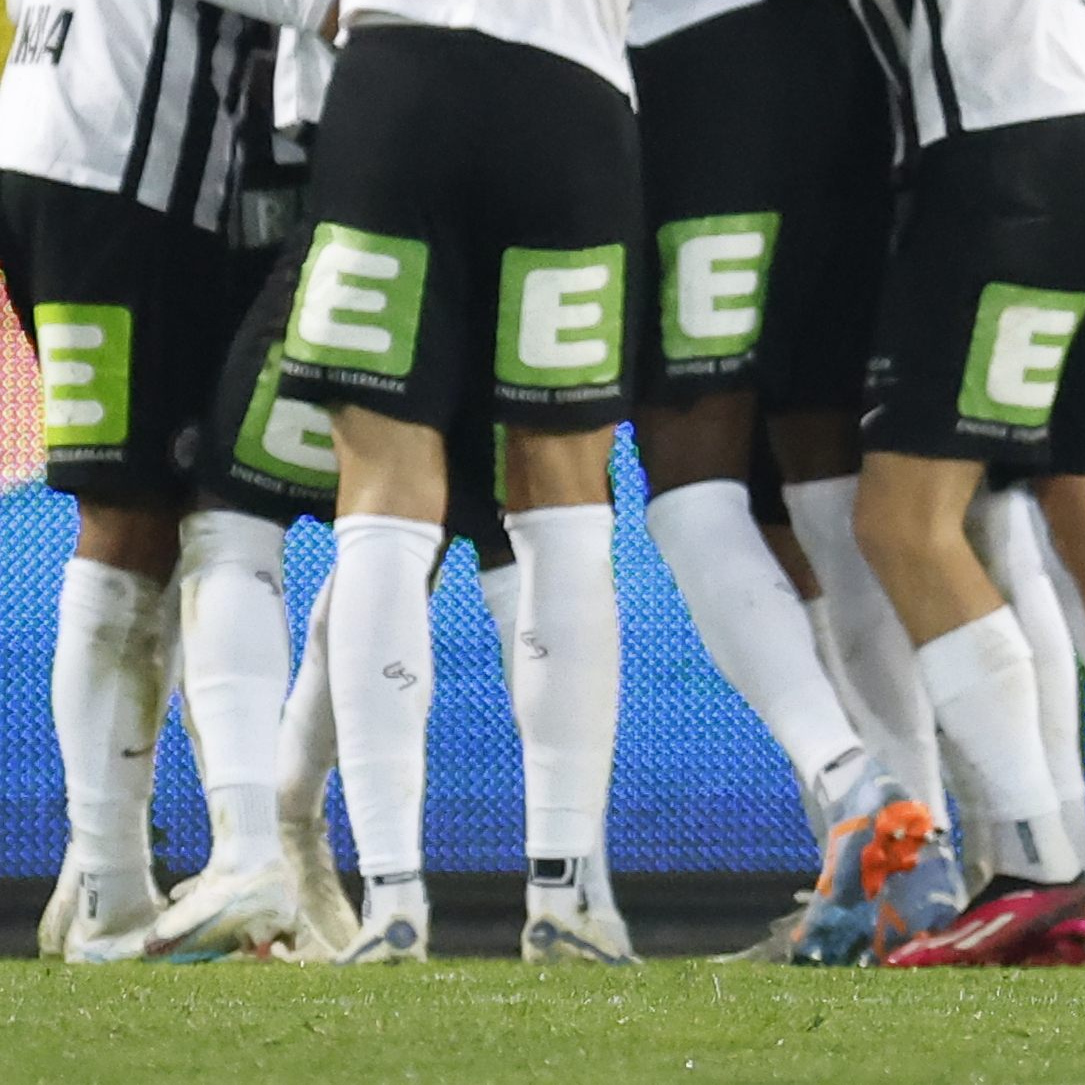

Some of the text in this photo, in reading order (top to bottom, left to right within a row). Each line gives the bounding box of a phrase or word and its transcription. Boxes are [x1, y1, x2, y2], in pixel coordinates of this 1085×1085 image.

[299, 242, 401, 354] E
[518, 265, 609, 368] E
[677, 232, 765, 339] E
[37, 322, 104, 428] E
[986, 306, 1077, 408] E
